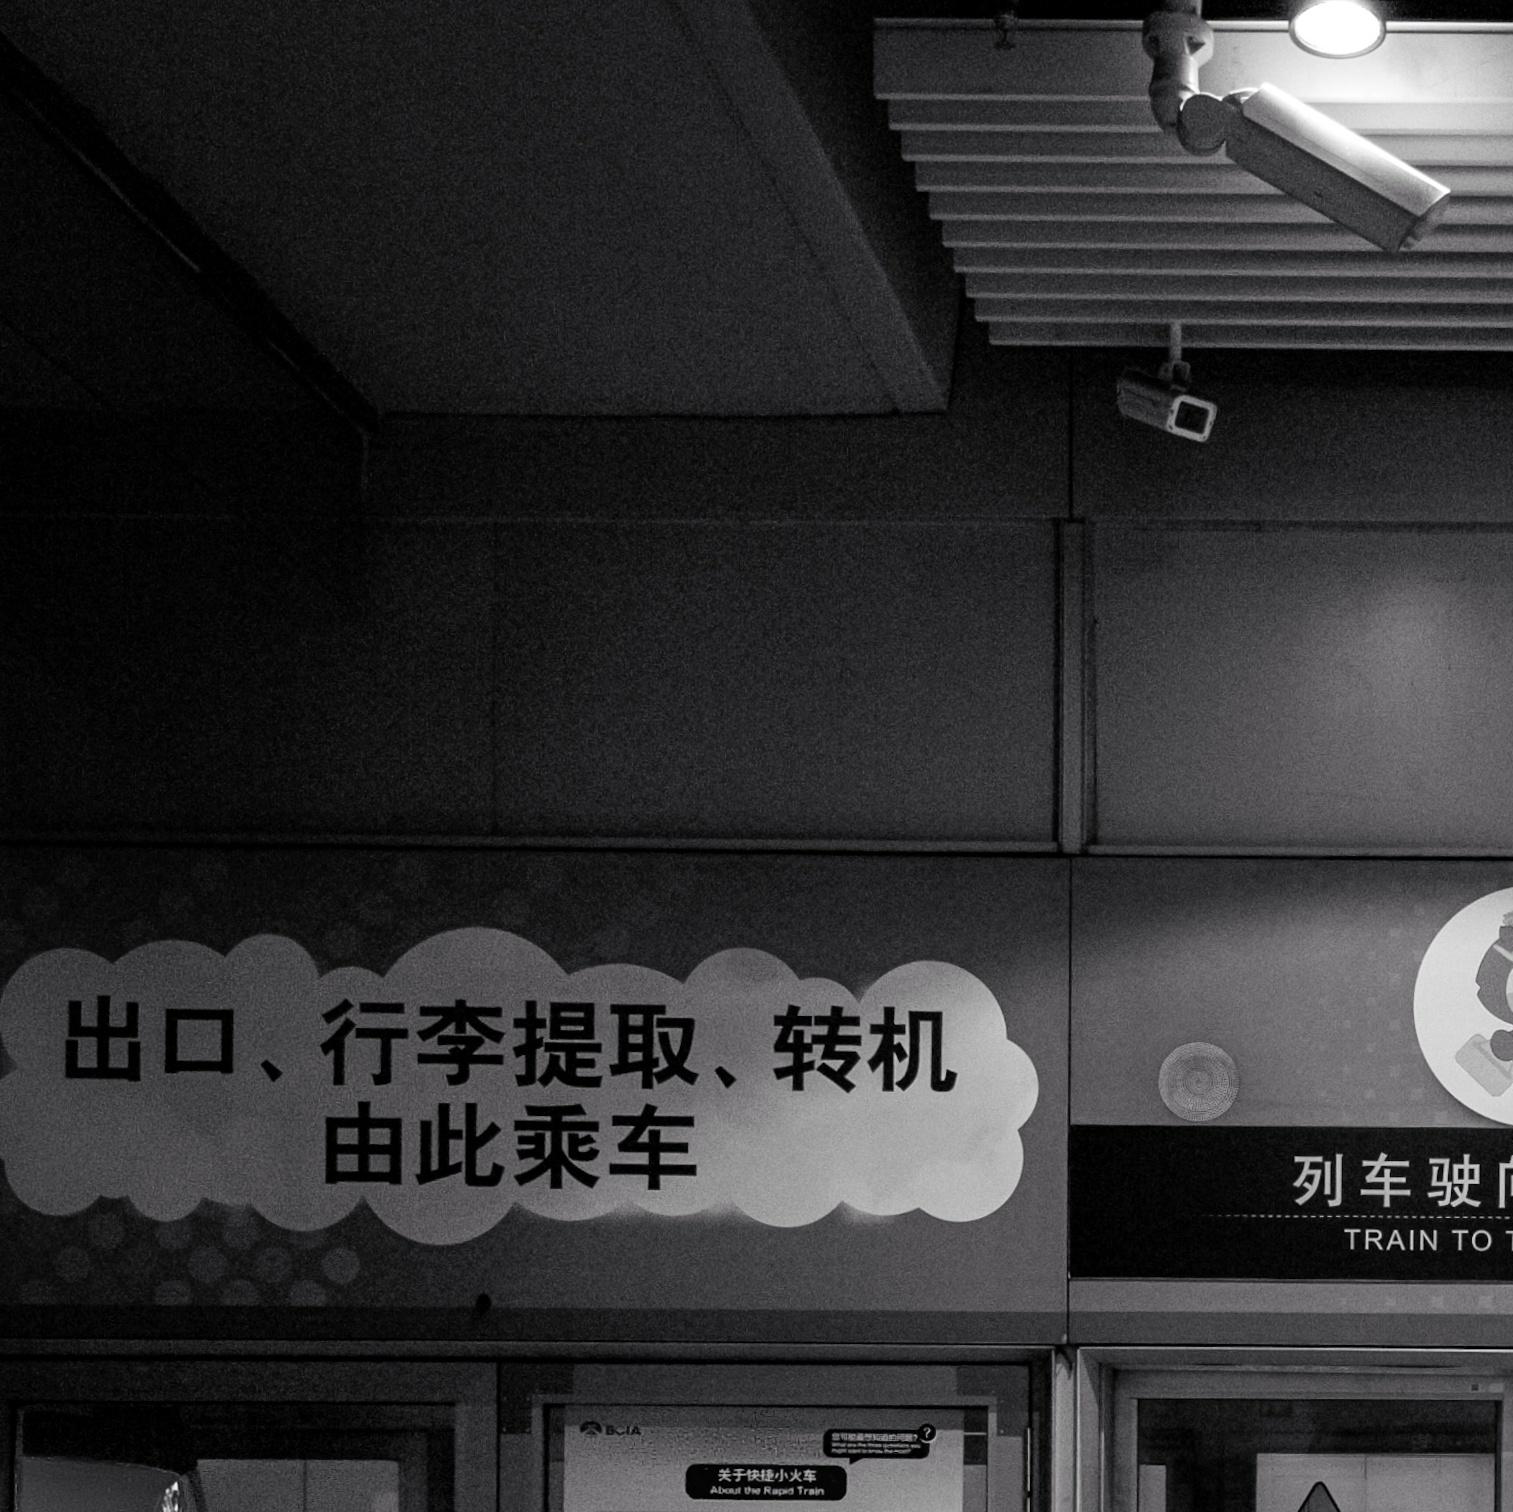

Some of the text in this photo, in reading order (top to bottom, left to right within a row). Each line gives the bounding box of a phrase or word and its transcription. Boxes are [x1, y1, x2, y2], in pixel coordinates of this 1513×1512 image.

[64, 994, 958, 1093] 出口、行李提取、转机
[324, 1100, 698, 1191] 由此乘车
[1343, 1228, 1439, 1252] TRAIN
[1451, 1229, 1493, 1252] TO
[709, 1485, 825, 1497] About the Rapid Train
